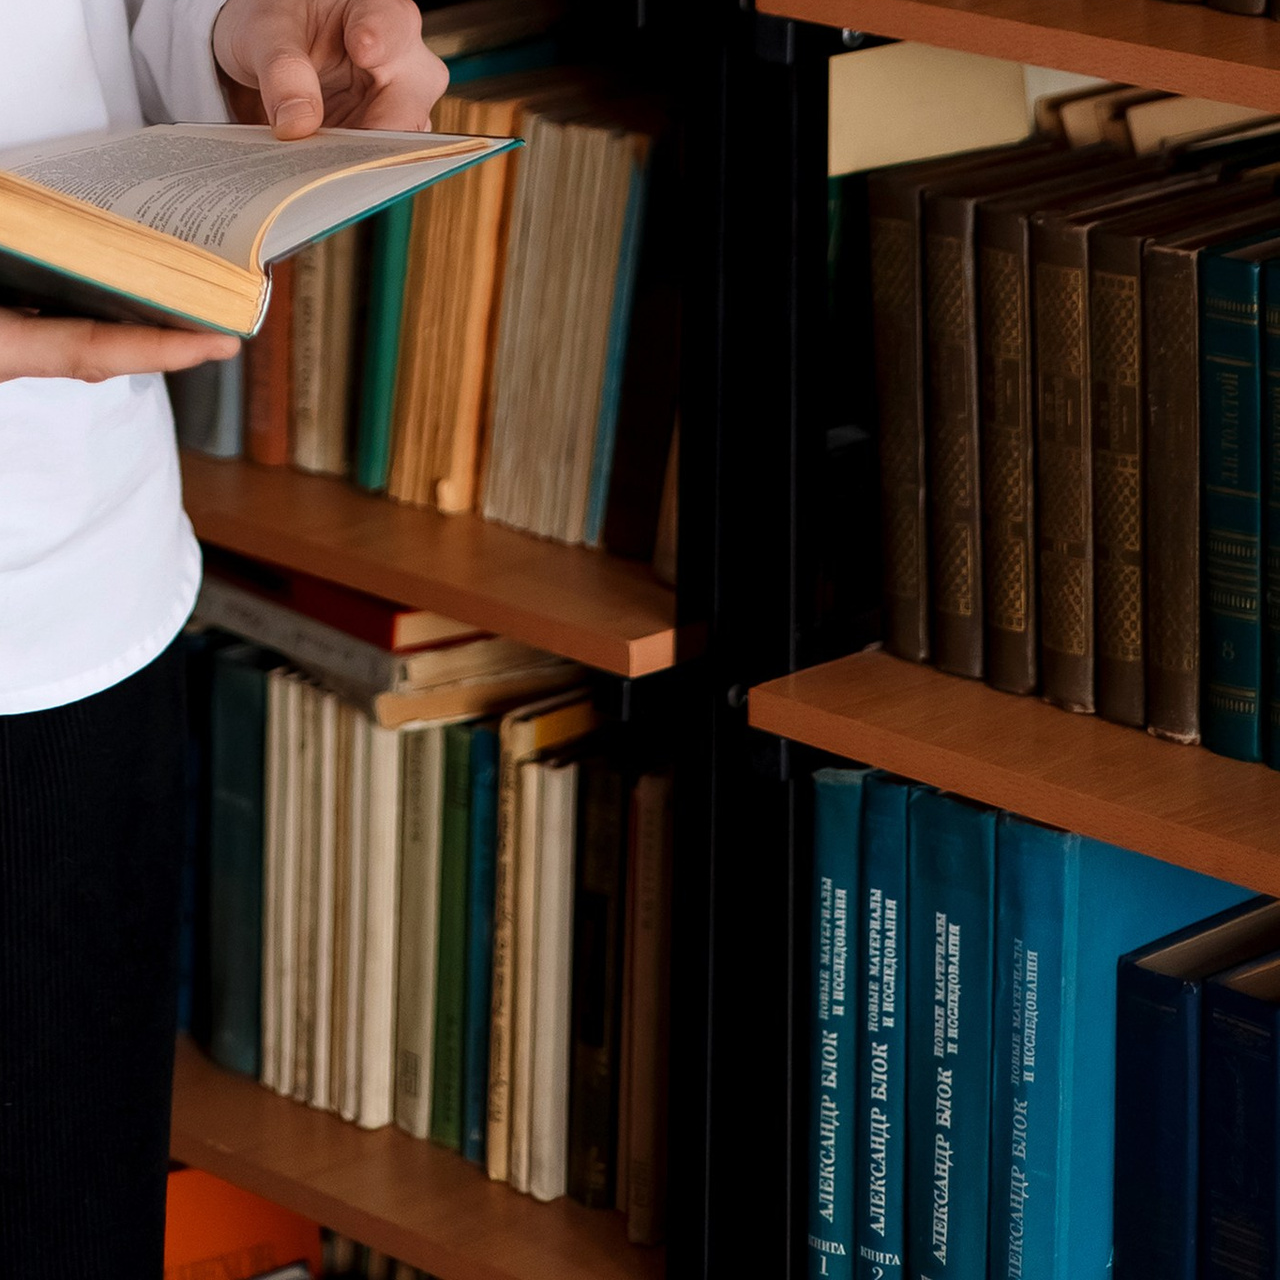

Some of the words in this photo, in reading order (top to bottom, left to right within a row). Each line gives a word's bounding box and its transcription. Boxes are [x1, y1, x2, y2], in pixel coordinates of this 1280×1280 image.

[821, 1030, 838, 1089] БЛОК
[871, 1041, 888, 1102] БЛОК
[936, 1067, 953, 1130] БЛОК
[1012, 1098, 1028, 1161] БЛОК
[818, 1095, 840, 1224] АЛЕКСАНДР
[870, 1107, 891, 1238] АЛЕКСАНДР
[932, 1133, 954, 1266] АЛЕКСАНДР
[1008, 1165, 1030, 1280] ЛЕКСАНДР
[820, 1255, 829, 1276] 1
[860, 1245, 901, 1266] КНИГА
